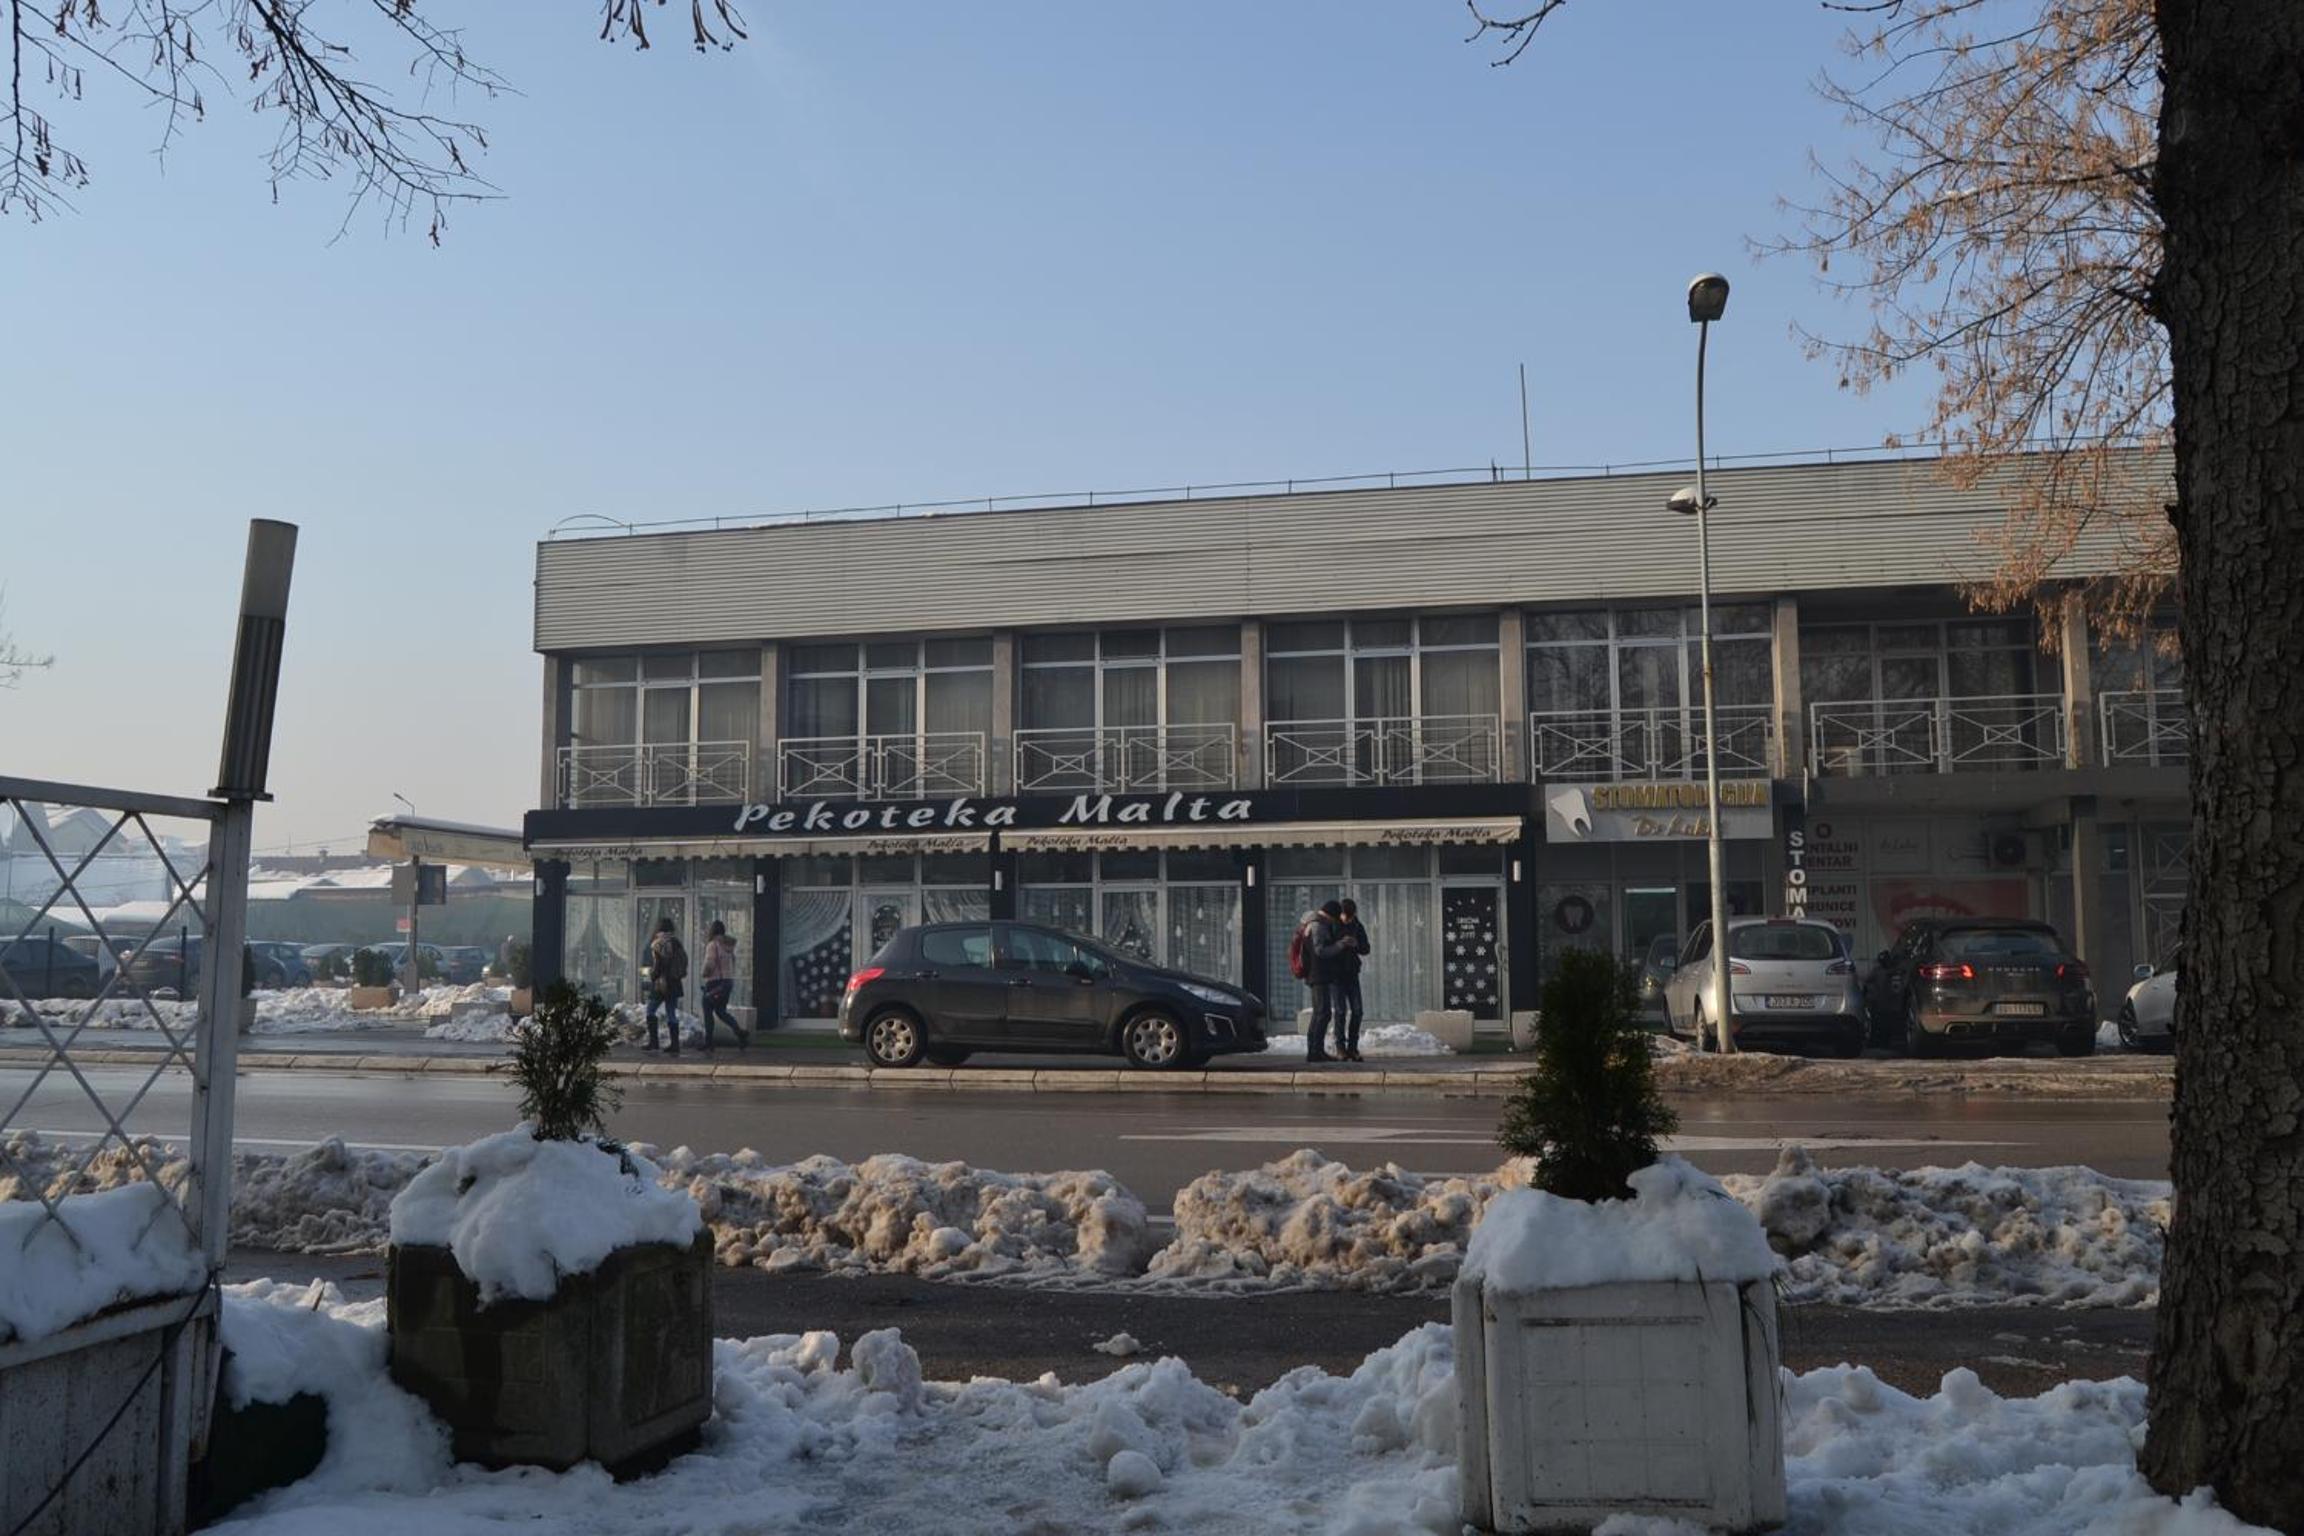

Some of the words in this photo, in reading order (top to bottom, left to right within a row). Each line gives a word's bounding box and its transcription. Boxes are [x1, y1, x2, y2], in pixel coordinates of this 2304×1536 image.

[1593, 784, 1768, 809] STOMATOLGIJA
[734, 798, 1017, 831] Pekoteka
[1057, 791, 1252, 823] Malta
[1087, 834, 1128, 845] Malta
[1444, 827, 1491, 838] Malta
